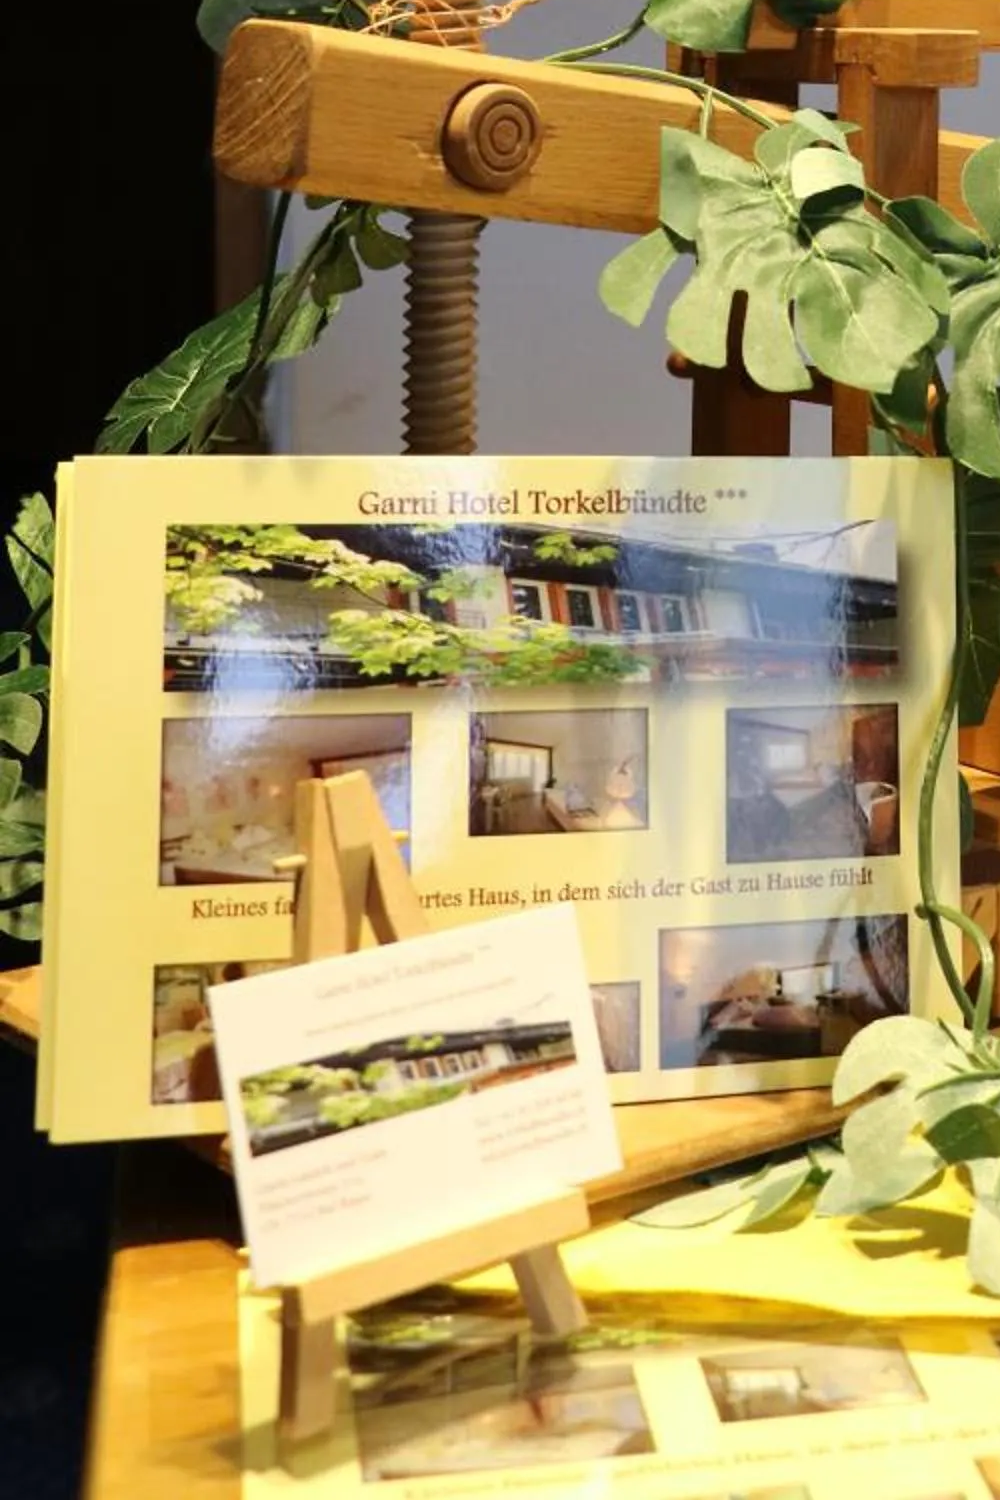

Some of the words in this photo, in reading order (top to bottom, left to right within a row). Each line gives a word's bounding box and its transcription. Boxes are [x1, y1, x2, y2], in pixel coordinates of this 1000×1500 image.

[358, 490, 437, 515] Garni
[448, 489, 520, 514] Hotel
[528, 488, 708, 515] Torkelbündte
[191, 897, 268, 919] Kleines
[468, 886, 527, 909] Haus,
[532, 881, 552, 903] in
[557, 882, 600, 902] dem
[607, 878, 646, 900] sich
[652, 876, 685, 898] der
[690, 874, 732, 896] Gast
[737, 875, 761, 894] zu
[766, 871, 824, 892] Hause
[829, 866, 874, 888] fühlt
